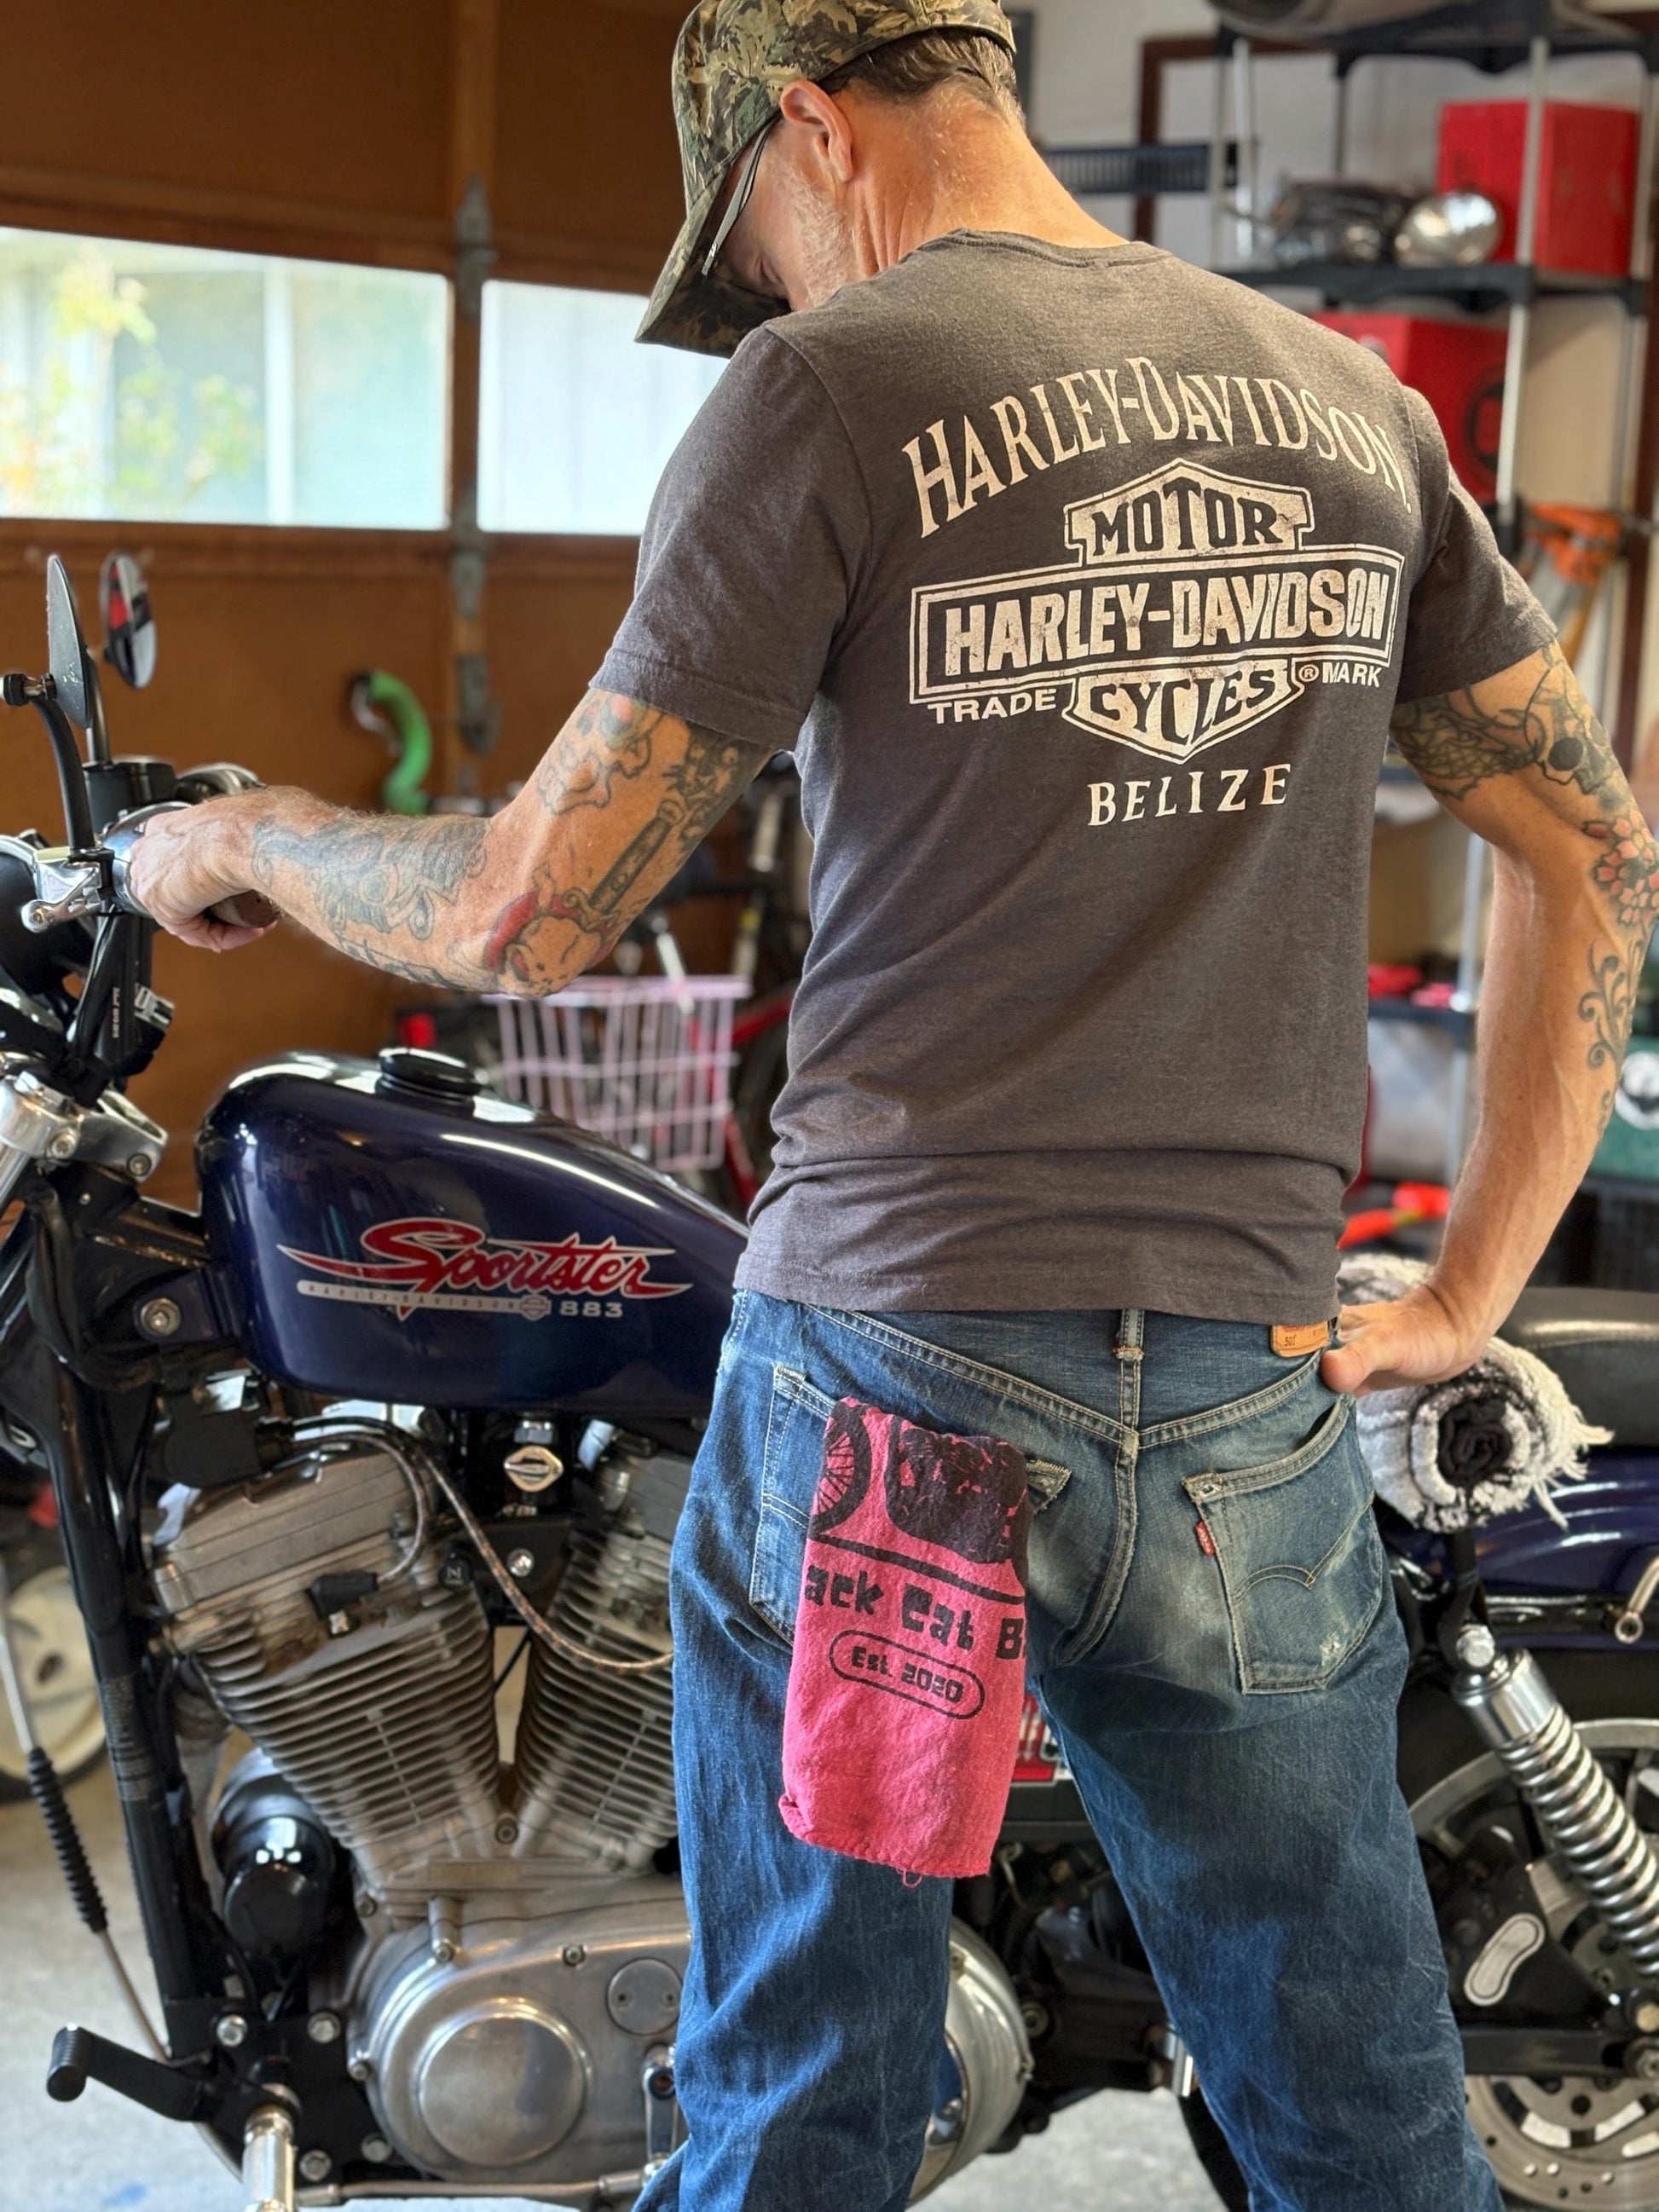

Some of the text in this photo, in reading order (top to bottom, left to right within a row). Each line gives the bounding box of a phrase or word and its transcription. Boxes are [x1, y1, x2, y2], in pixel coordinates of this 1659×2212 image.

[1092, 476, 1284, 557] MOTOR
[945, 569, 1390, 676] HARLEY-DAVIDSON
[928, 689, 1056, 725] TRADE
[1090, 663, 1276, 746] CYCLES
[1087, 764, 1292, 827] BELIZE
[276, 1216, 693, 1321] Sportster
[559, 1302, 624, 1318] 883
[900, 1662, 965, 1704] 2020
